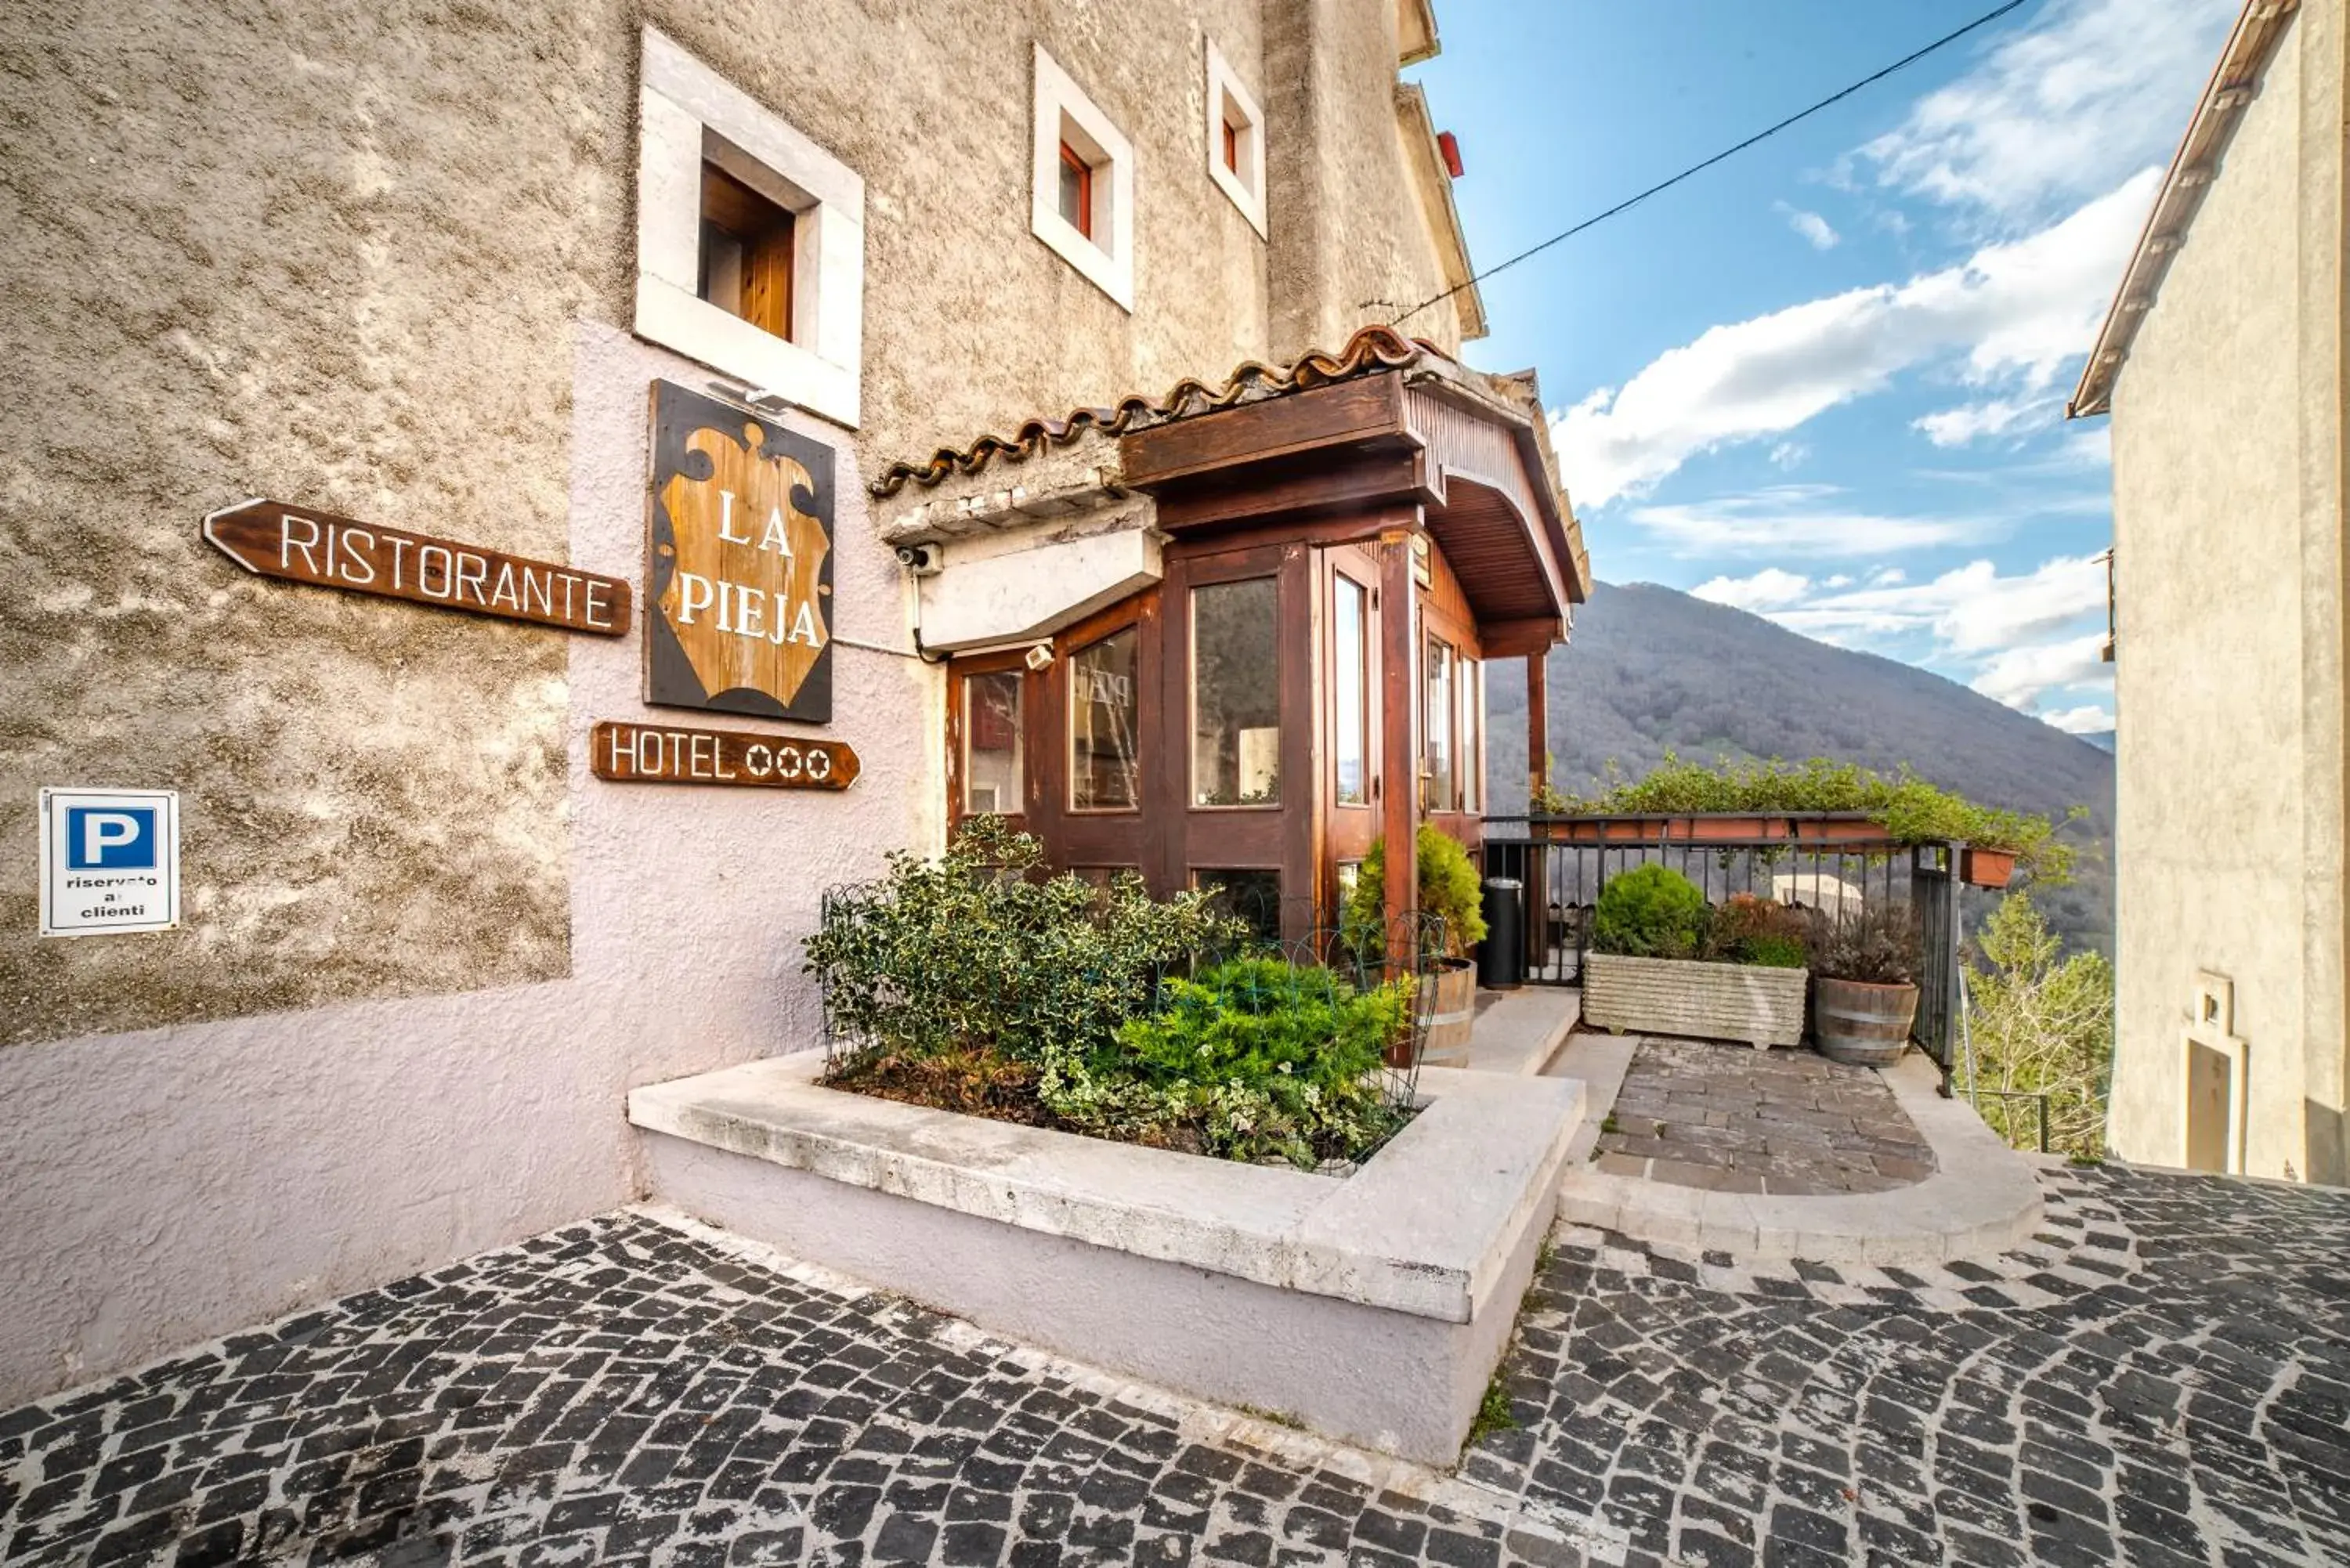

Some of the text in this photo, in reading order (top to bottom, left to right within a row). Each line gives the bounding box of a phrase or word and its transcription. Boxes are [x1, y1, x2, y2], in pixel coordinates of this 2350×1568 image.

[718, 490, 793, 558] LA
[280, 514, 613, 627] RISTORANTE
[678, 571, 826, 649] PIEJA
[610, 727, 736, 779] HOTEL
[85, 813, 140, 864] P
[81, 905, 145, 918] clienti
